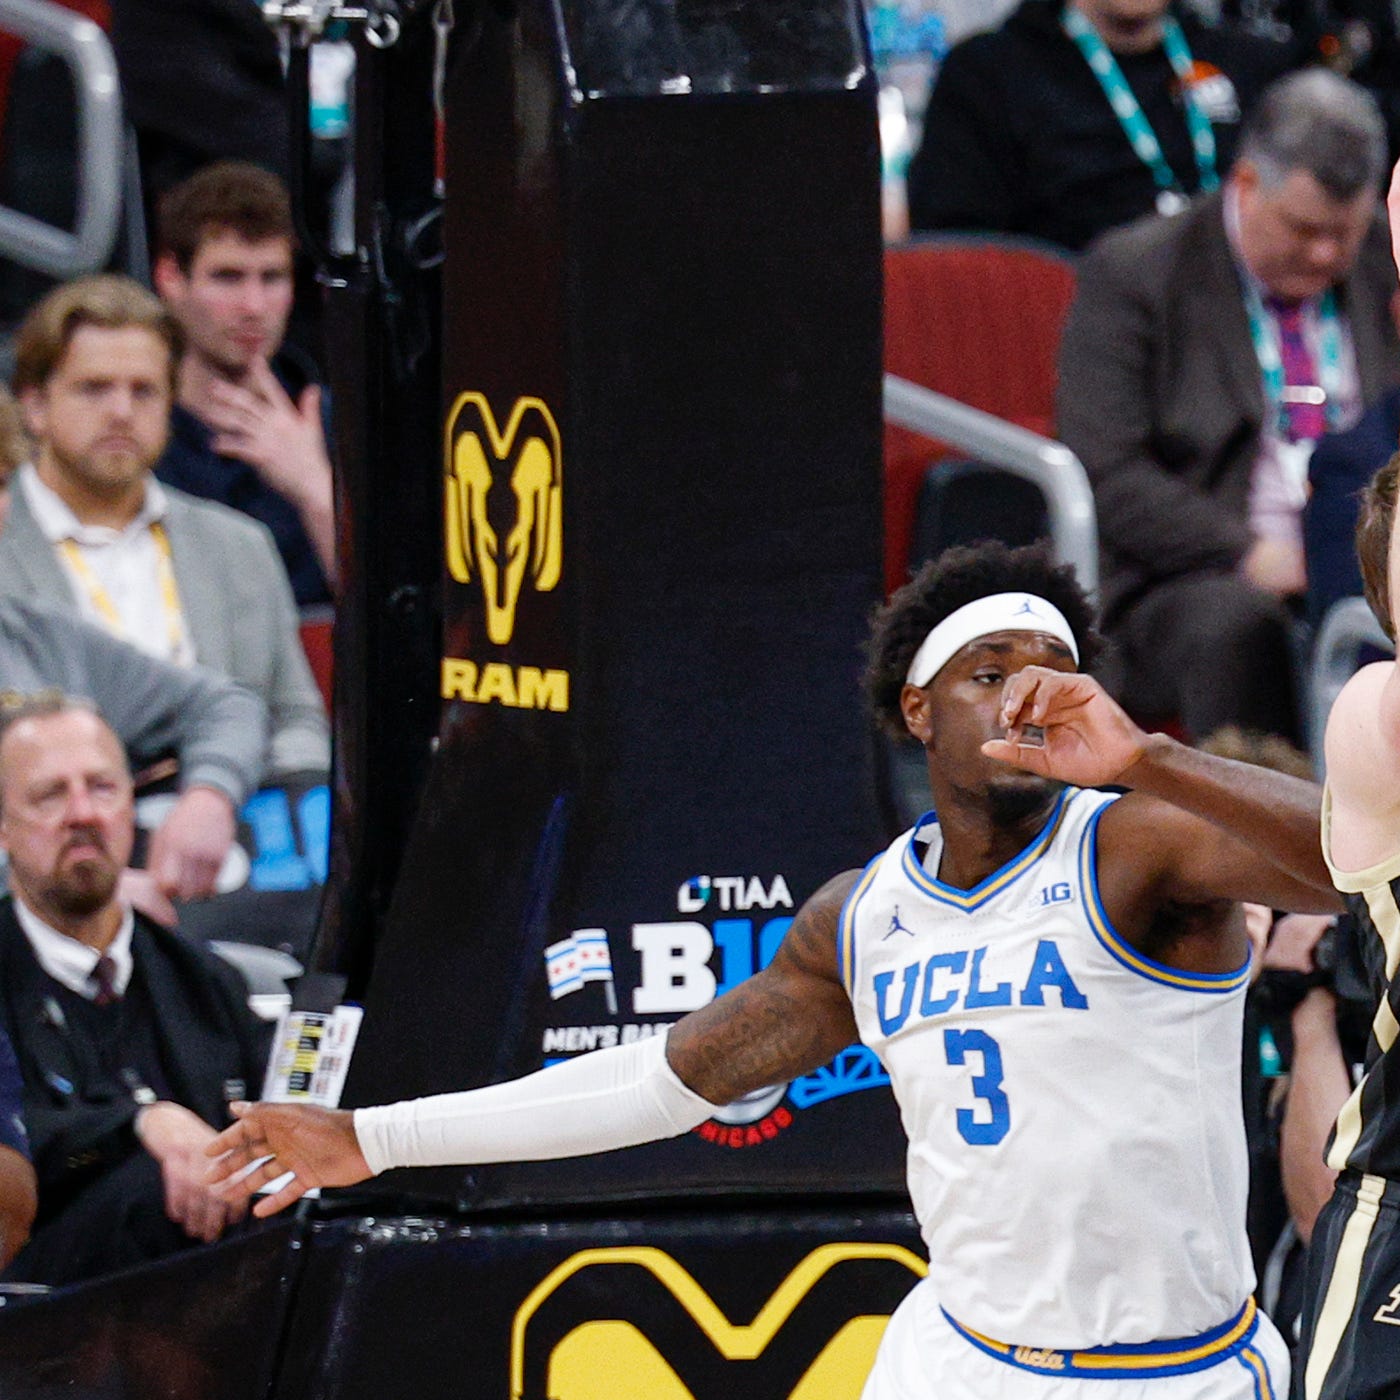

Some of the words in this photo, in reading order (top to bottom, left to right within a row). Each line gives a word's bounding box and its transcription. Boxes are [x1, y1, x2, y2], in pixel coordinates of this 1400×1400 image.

[440, 656, 569, 712] RAM
[712, 873, 793, 911] TIAA
[873, 940, 1090, 1037] UCLA
[542, 1025, 618, 1053] MEN'S
[943, 1029, 1011, 1145] 3
[691, 1106, 794, 1150] HICAGO
